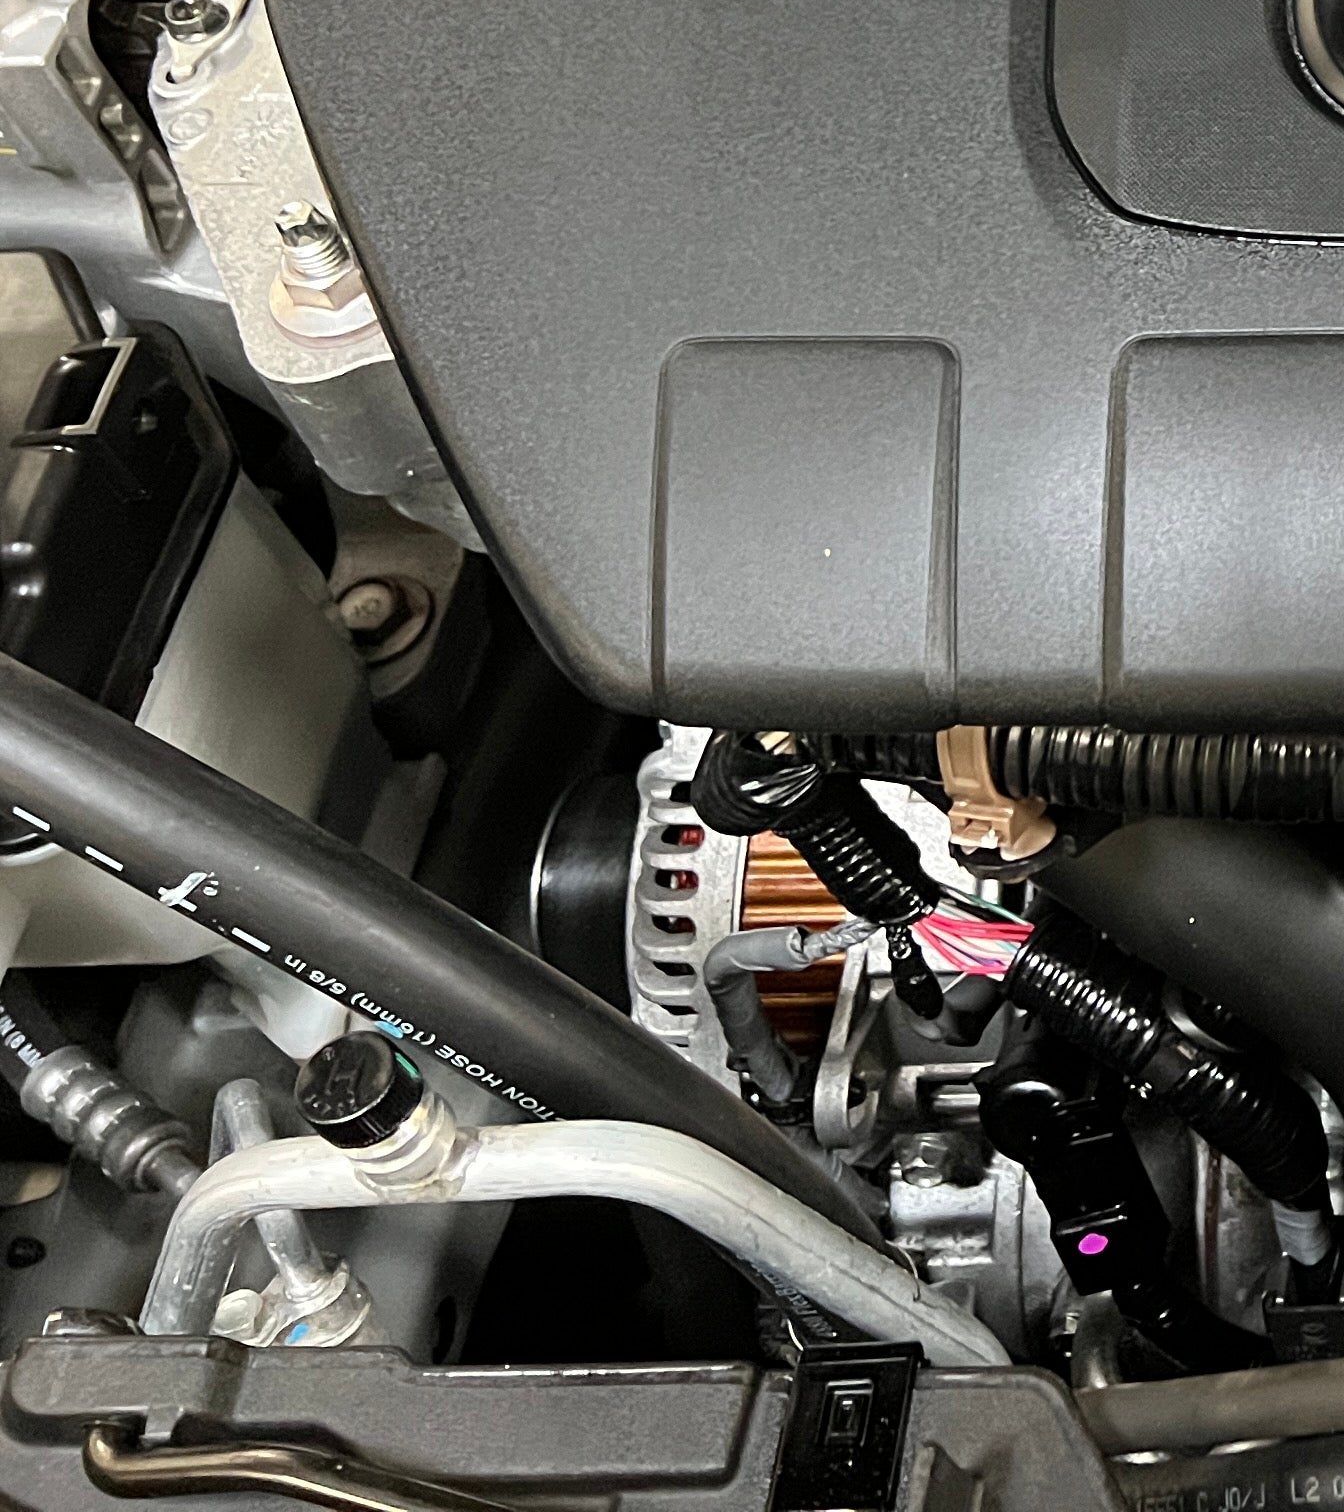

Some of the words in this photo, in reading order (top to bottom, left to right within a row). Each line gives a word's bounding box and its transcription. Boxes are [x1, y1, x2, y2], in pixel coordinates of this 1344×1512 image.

[308, 969, 347, 995] 5/8
[350, 992, 436, 1047] (16mm)
[434, 1044, 503, 1088] HOSE
[502, 1086, 566, 1122] TION
